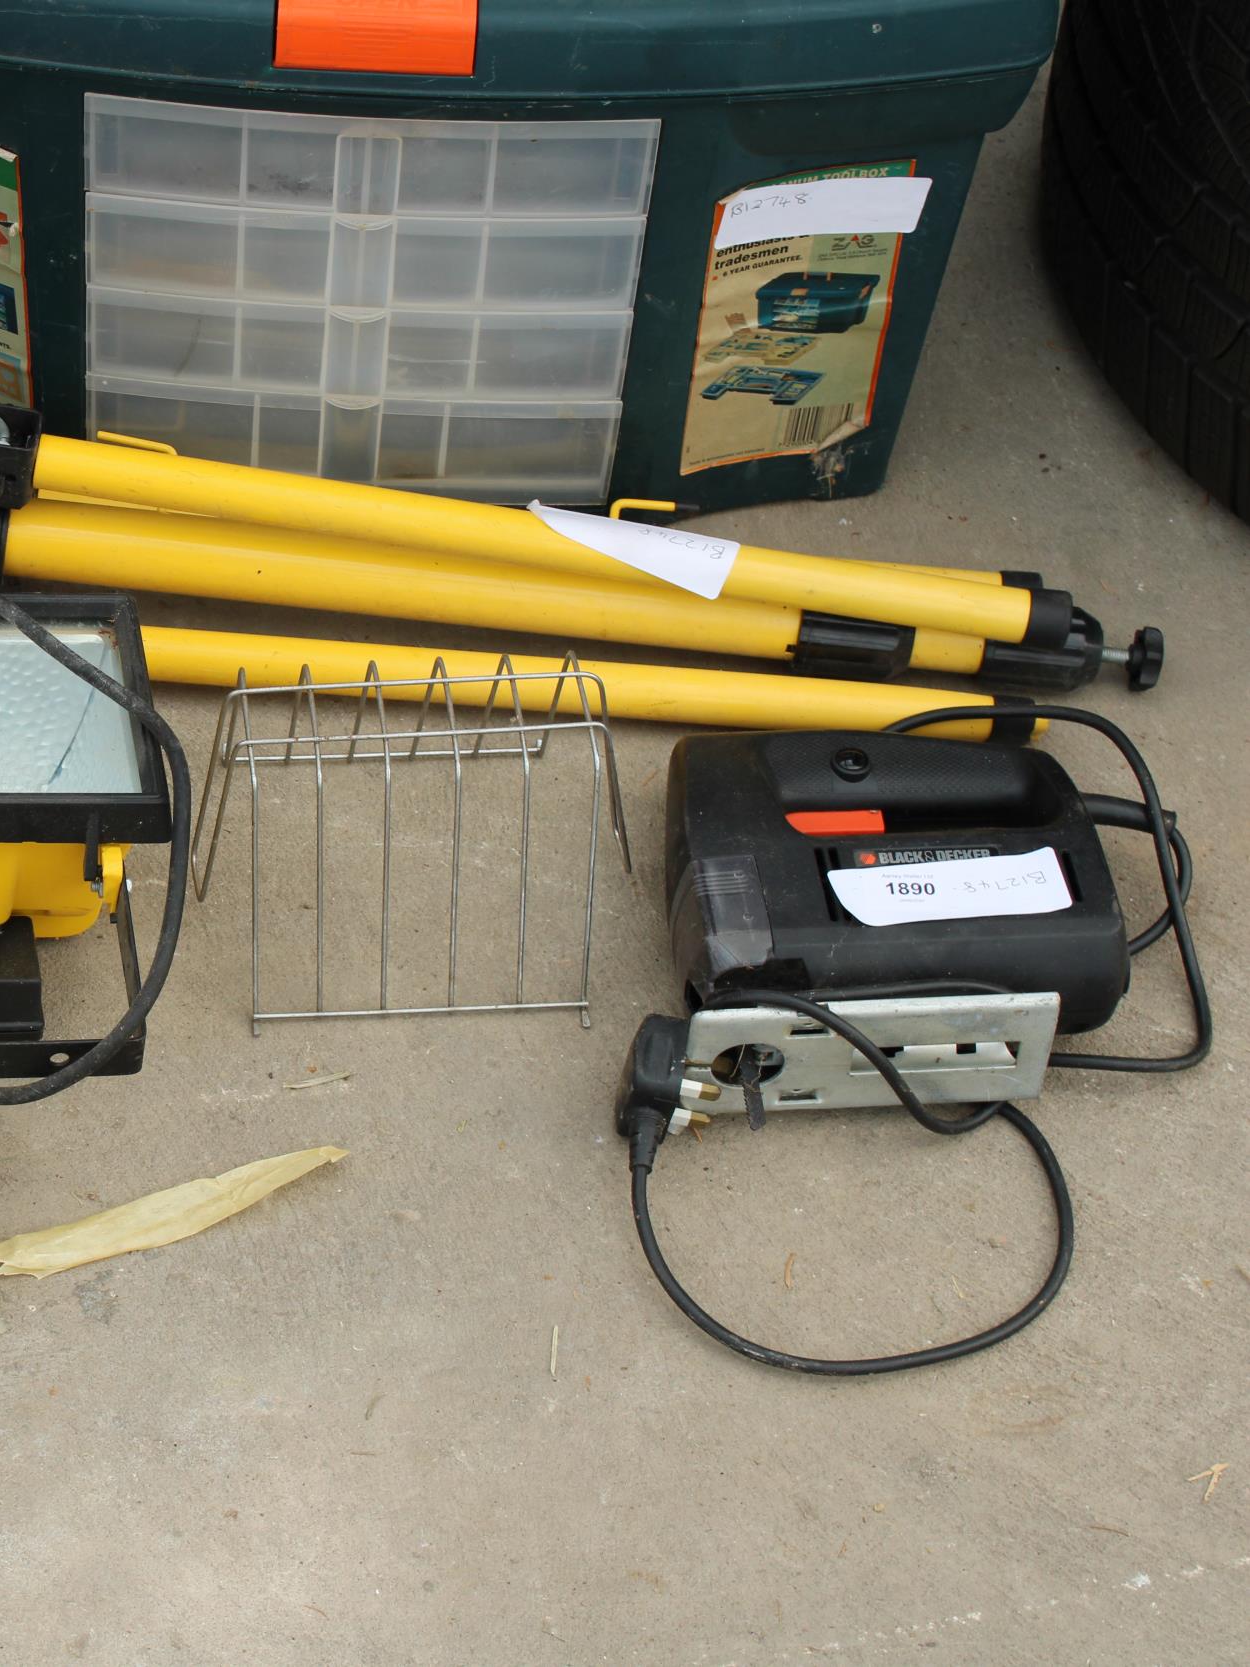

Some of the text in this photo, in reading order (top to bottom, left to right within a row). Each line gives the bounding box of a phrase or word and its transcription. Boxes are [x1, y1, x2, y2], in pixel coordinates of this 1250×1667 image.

[714, 245, 789, 270] tradesmen
[730, 265, 750, 275] YEAR
[752, 255, 803, 270] GUARANTEE.
[878, 848, 991, 864] BLACK&DECKER
[885, 882, 936, 896] 1890
